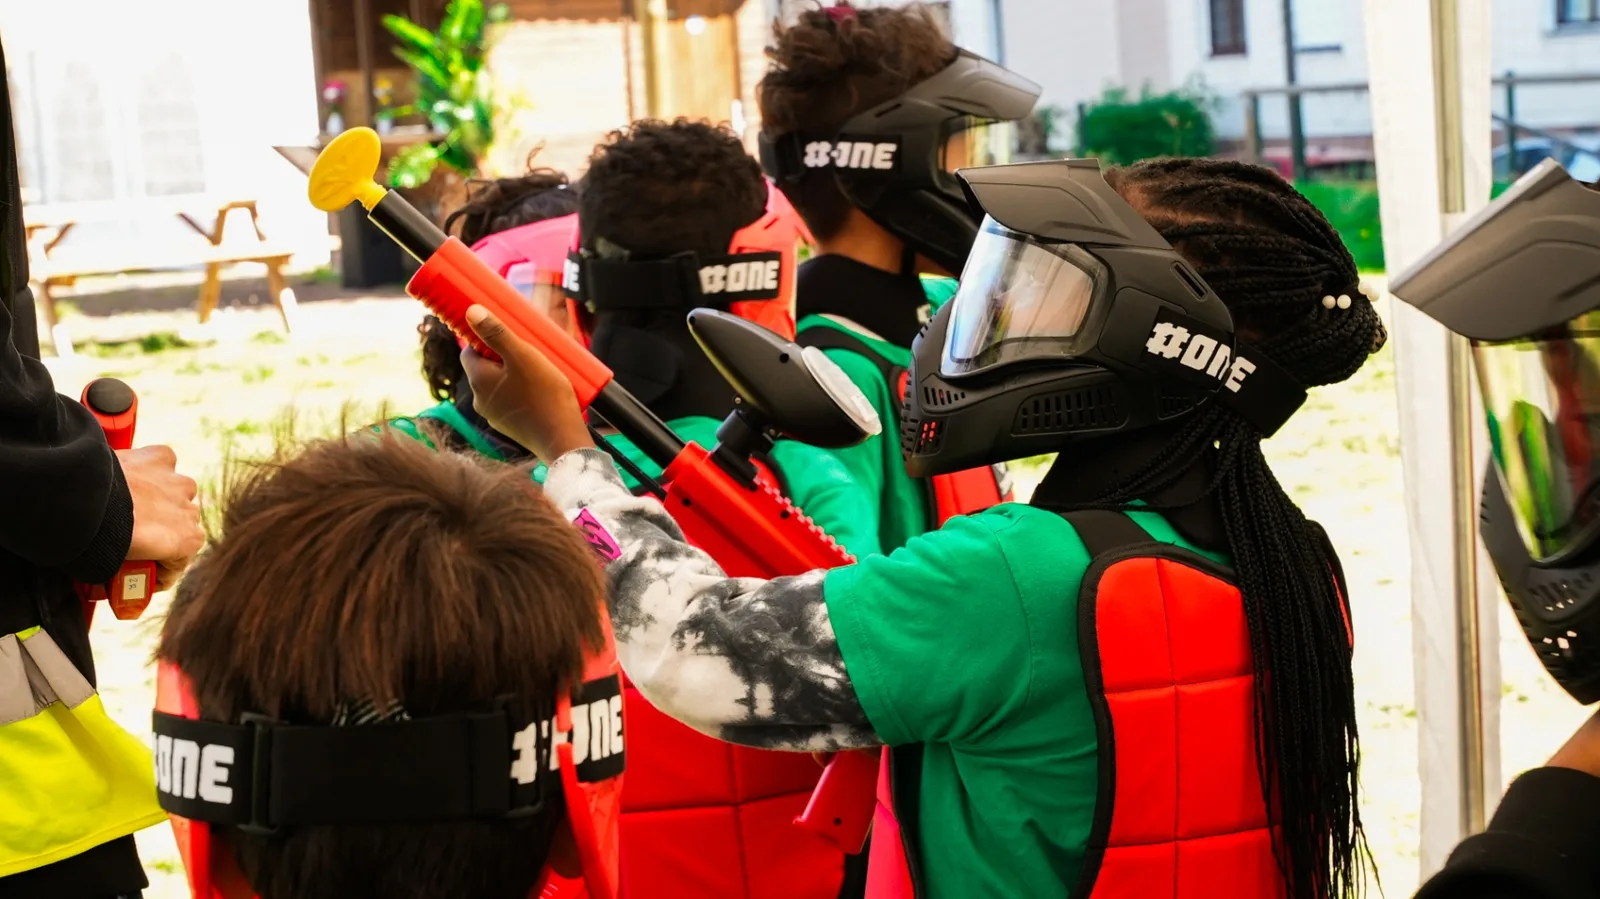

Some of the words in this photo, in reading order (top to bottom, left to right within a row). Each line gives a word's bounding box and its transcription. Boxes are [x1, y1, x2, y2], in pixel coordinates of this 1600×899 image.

[699, 260, 779, 294] #ONE
[1145, 322, 1257, 393] #ONE
[153, 732, 235, 804] ONE
